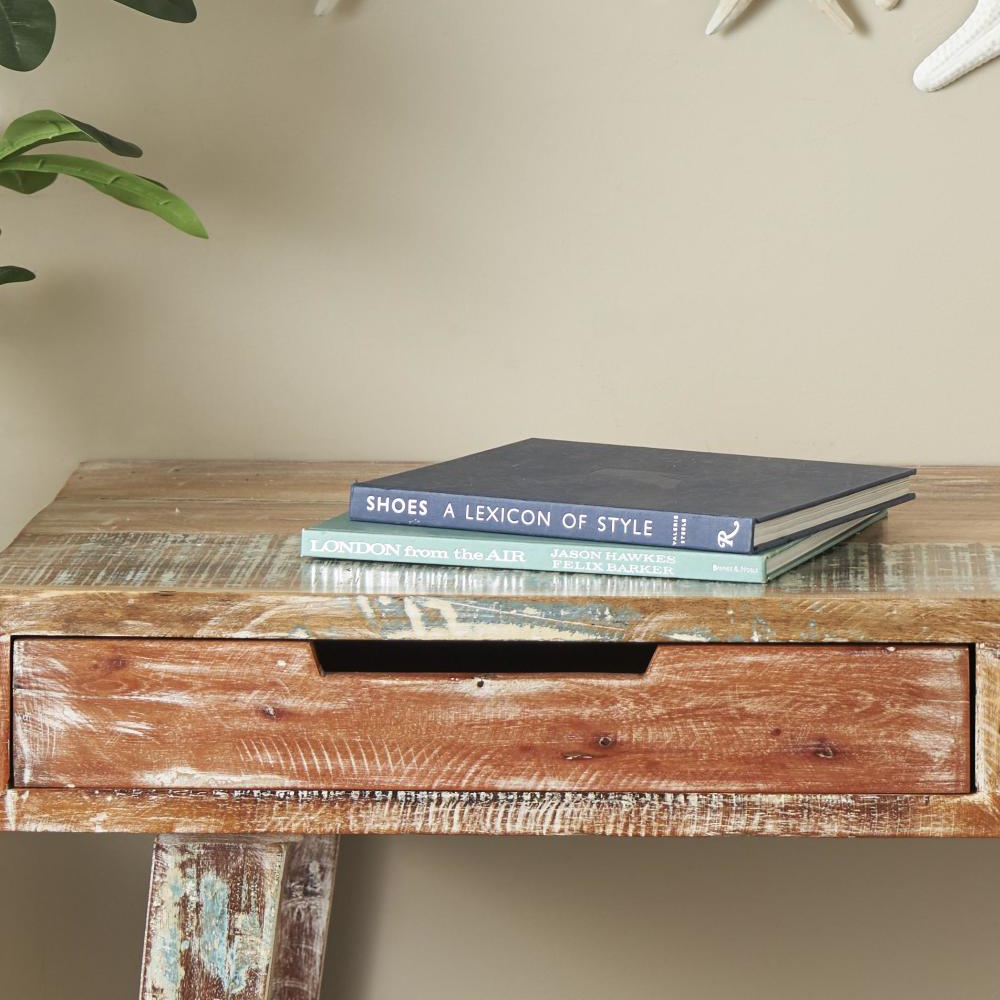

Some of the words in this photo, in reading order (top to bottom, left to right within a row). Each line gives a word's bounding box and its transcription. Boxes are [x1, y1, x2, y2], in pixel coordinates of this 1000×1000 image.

[366, 495, 428, 516] SHOES
[443, 502, 456, 519] A
[465, 504, 551, 527] LEXICON
[562, 512, 588, 530] OF
[597, 515, 653, 537] STYLE
[717, 520, 740, 549] R
[310, 539, 401, 556] LONDON
[404, 545, 449, 559] from
[453, 548, 484, 561] the
[485, 549, 526, 562] AIR
[550, 548, 602, 560] JASON
[605, 551, 677, 564] HAWKES
[552, 559, 604, 571] FELIX
[606, 562, 674, 576] BARKER
